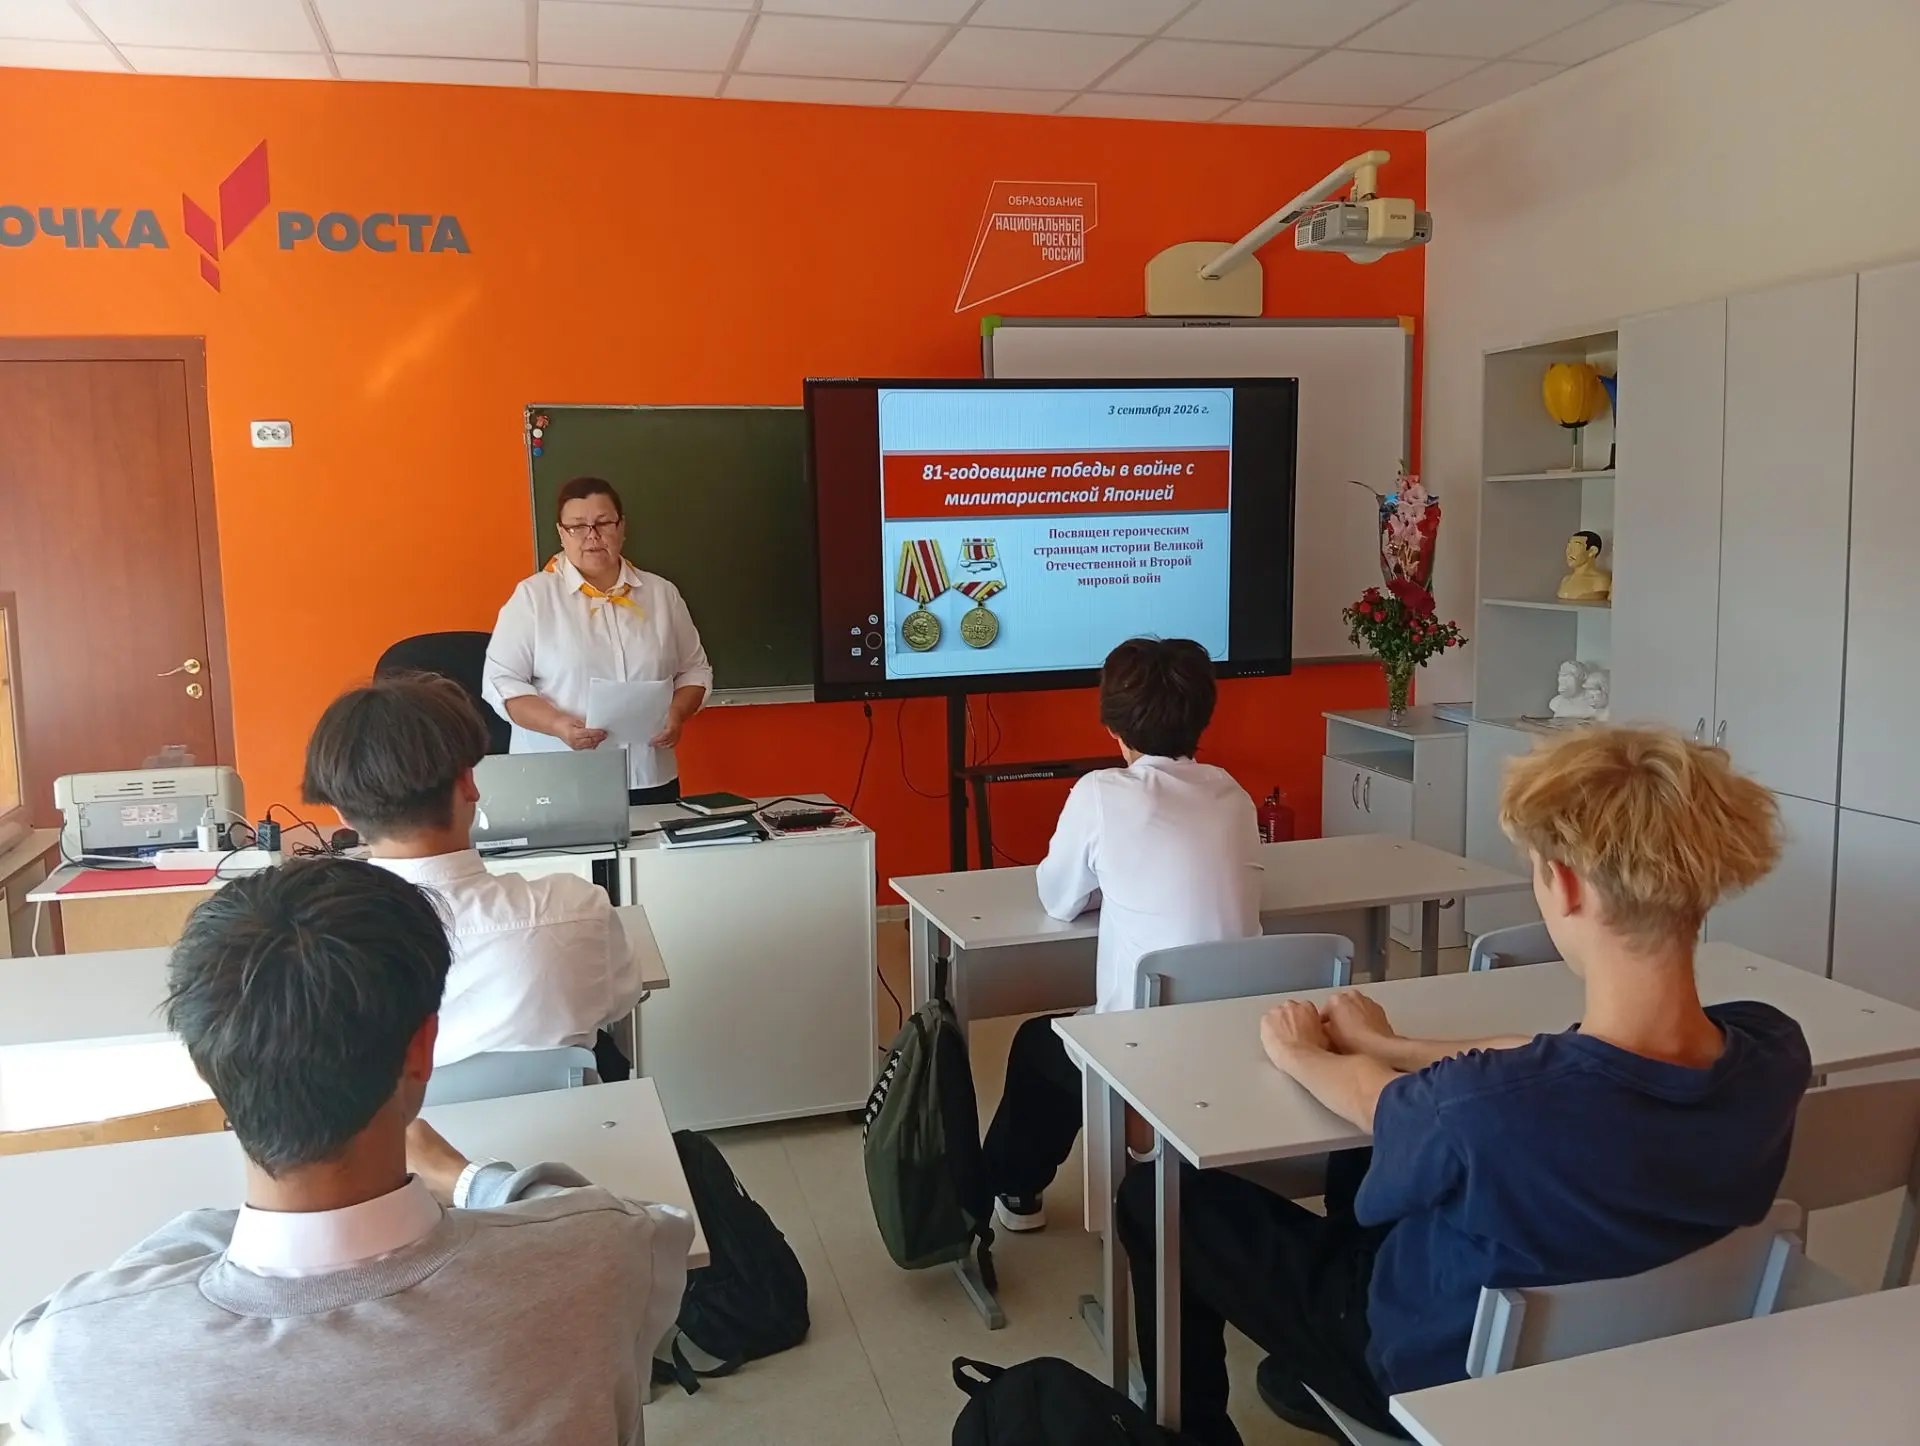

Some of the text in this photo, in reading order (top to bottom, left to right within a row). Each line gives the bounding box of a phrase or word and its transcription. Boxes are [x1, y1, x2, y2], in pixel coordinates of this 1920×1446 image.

[1008, 195, 1084, 207] ОБРАЗОВАНИЕ
[995, 216, 1081, 232] НАЦИОНАЛЬНЫЕ
[277, 211, 472, 254] РОСТА
[1032, 232, 1081, 247] ПРОЕКТЫ
[1041, 247, 1081, 261] РОССИИ
[1107, 404, 1210, 417] 3 сентября 2026 г.
[922, 460, 1195, 482] 81-годовщине победы в войне с
[944, 484, 1175, 508] милитаристской Японией
[1048, 526, 1190, 540] Посвящен героическим
[1033, 538, 1204, 558] страницам истории Великой
[1046, 555, 1193, 572] Отечественной и Второй
[1077, 572, 1161, 588] мировой войн
